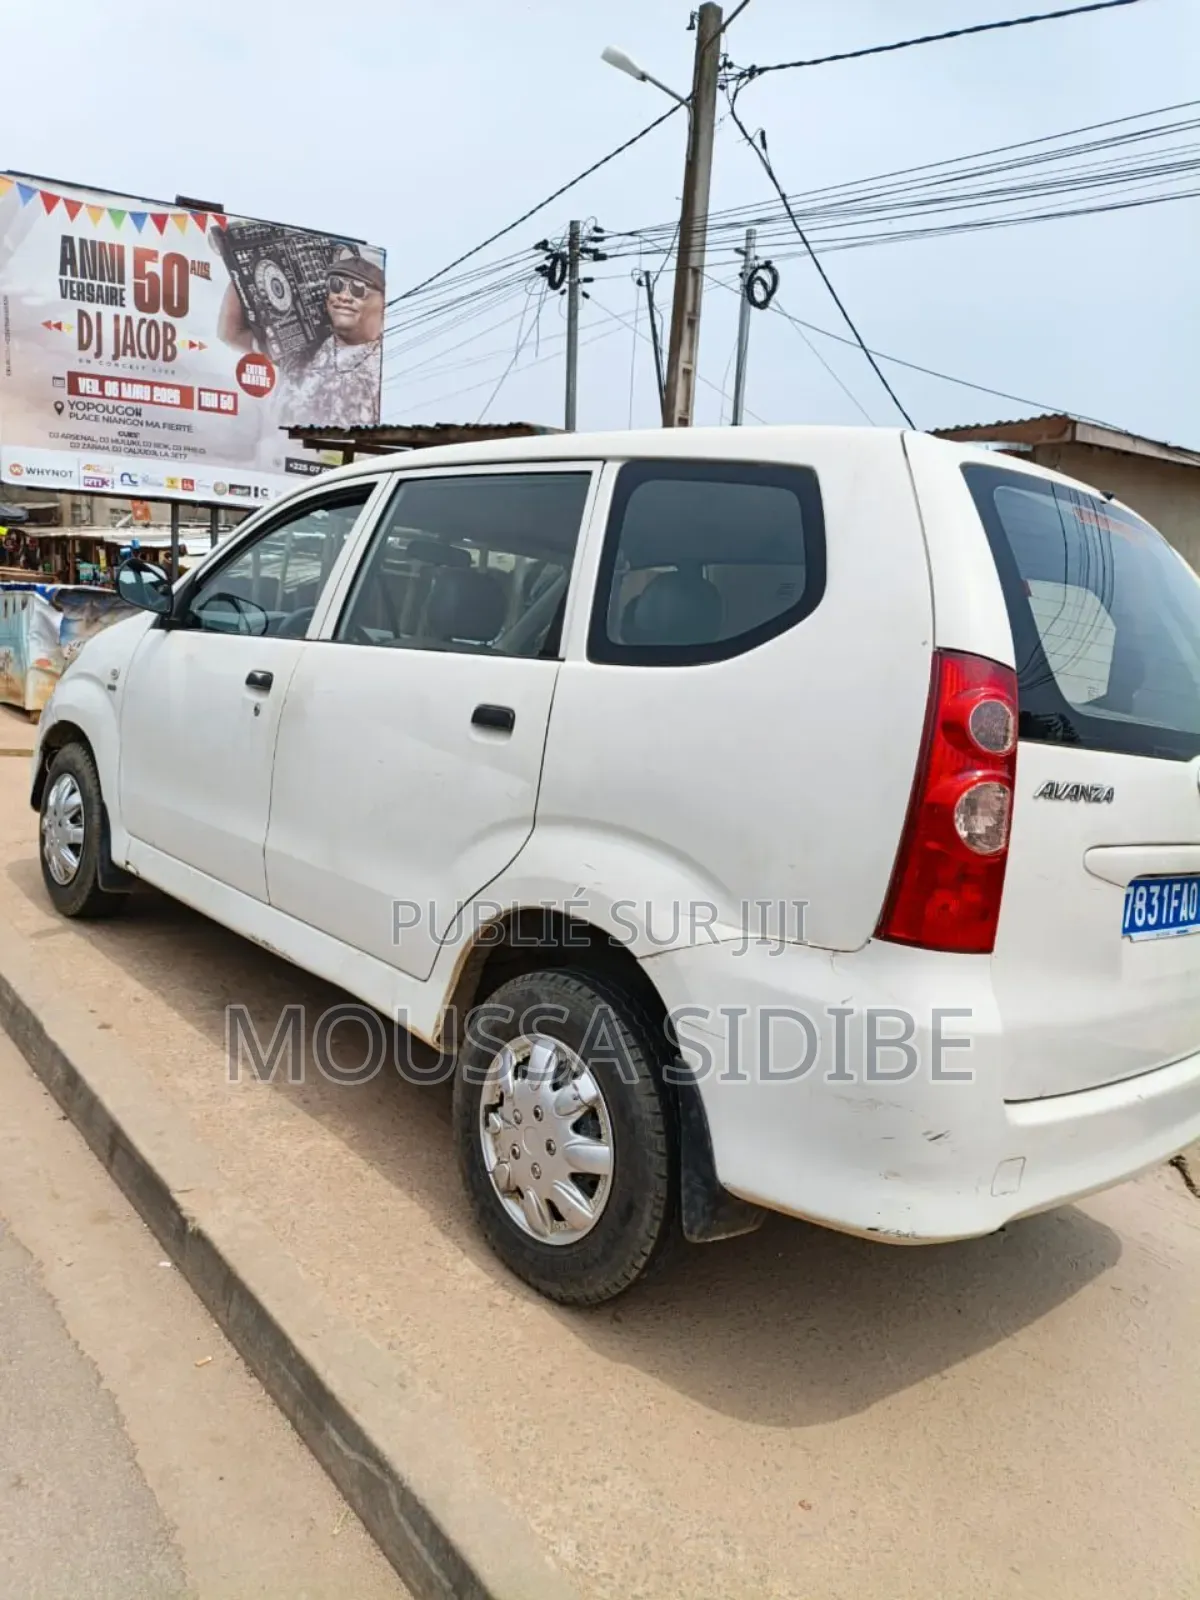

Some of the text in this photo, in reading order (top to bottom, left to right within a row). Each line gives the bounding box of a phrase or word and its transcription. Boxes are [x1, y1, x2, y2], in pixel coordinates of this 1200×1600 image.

[59, 234, 126, 285] ANNI
[58, 278, 126, 307] VERSAIRE
[133, 246, 190, 318] 50
[77, 308, 177, 362] DJ JACOB
[67, 400, 142, 417] YOPOUGON
[69, 412, 100, 422] PLACE
[145, 421, 161, 429] MA
[25, 466, 74, 479] WHYNOT
[1033, 780, 1115, 804] AVANZA
